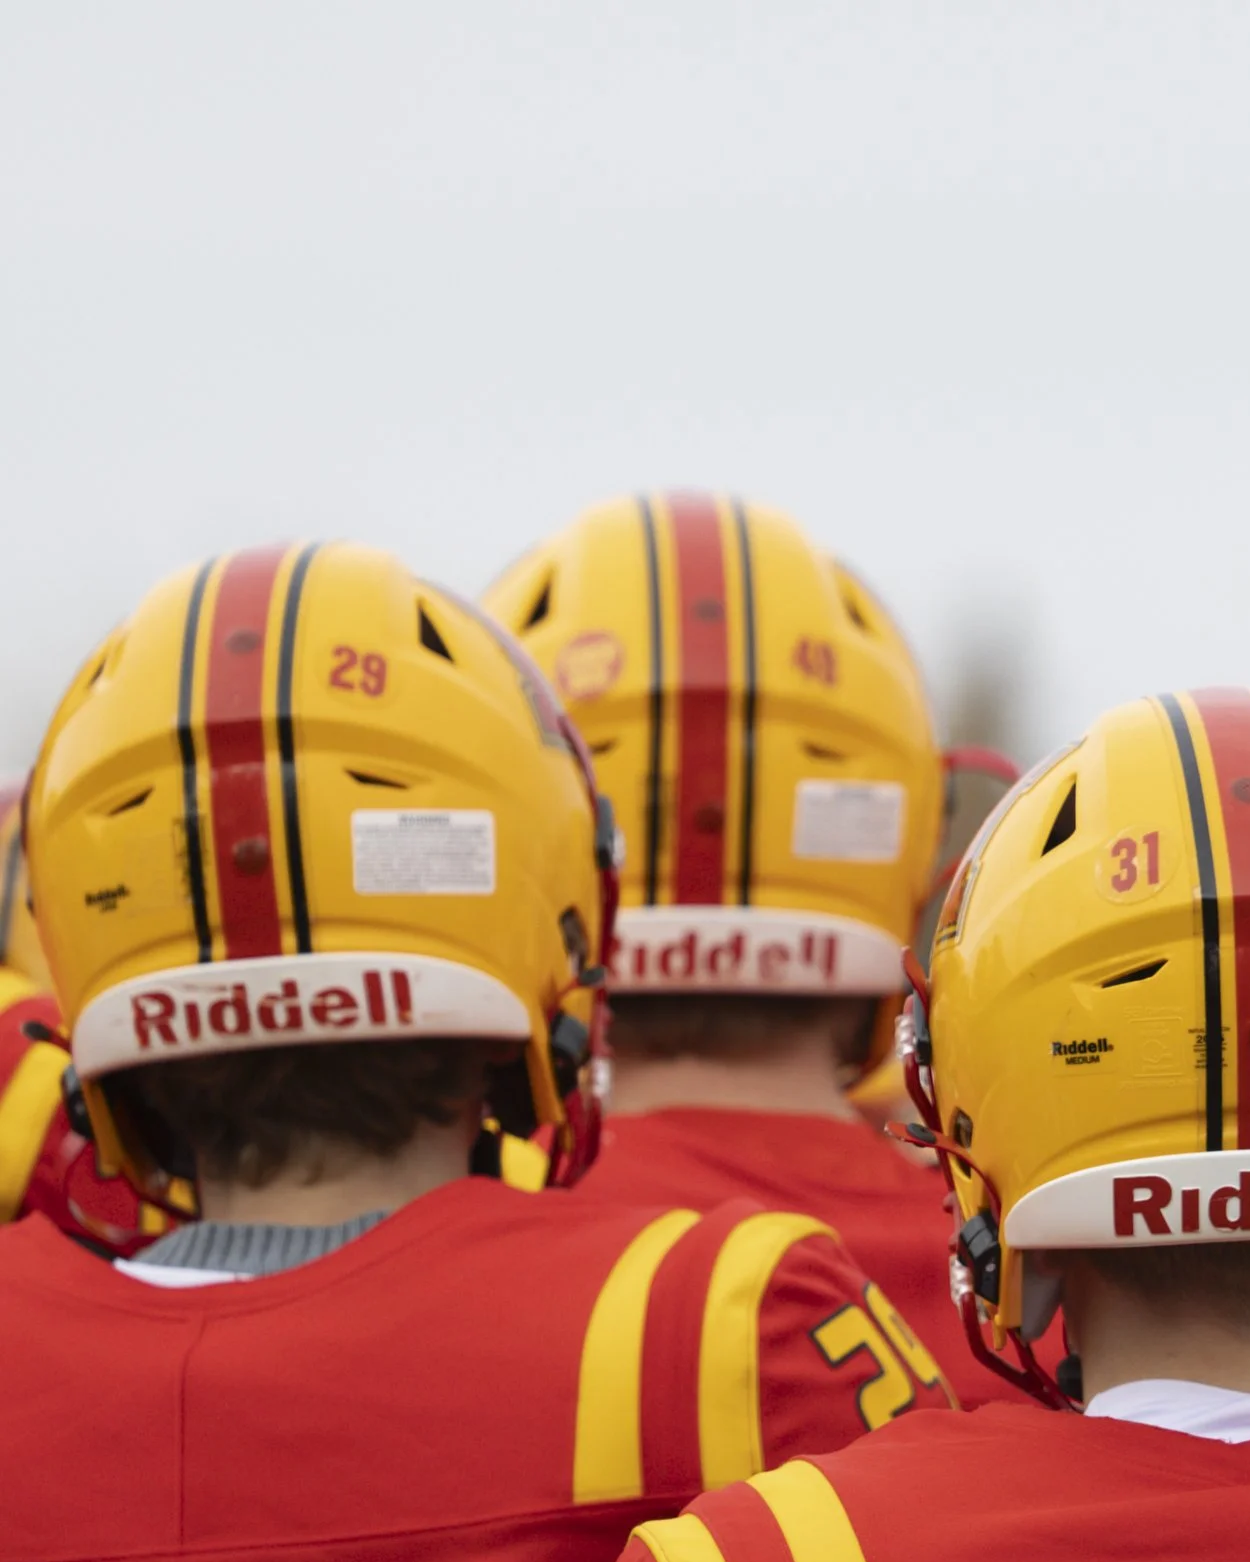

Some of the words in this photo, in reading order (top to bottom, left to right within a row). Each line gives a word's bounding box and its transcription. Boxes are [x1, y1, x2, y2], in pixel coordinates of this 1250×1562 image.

[330, 644, 388, 698] 29
[1110, 831, 1160, 893] 31
[131, 970, 414, 1050] Riddell
[1051, 1038, 1109, 1056] Riddell
[1065, 1055, 1100, 1066] MEDIUM
